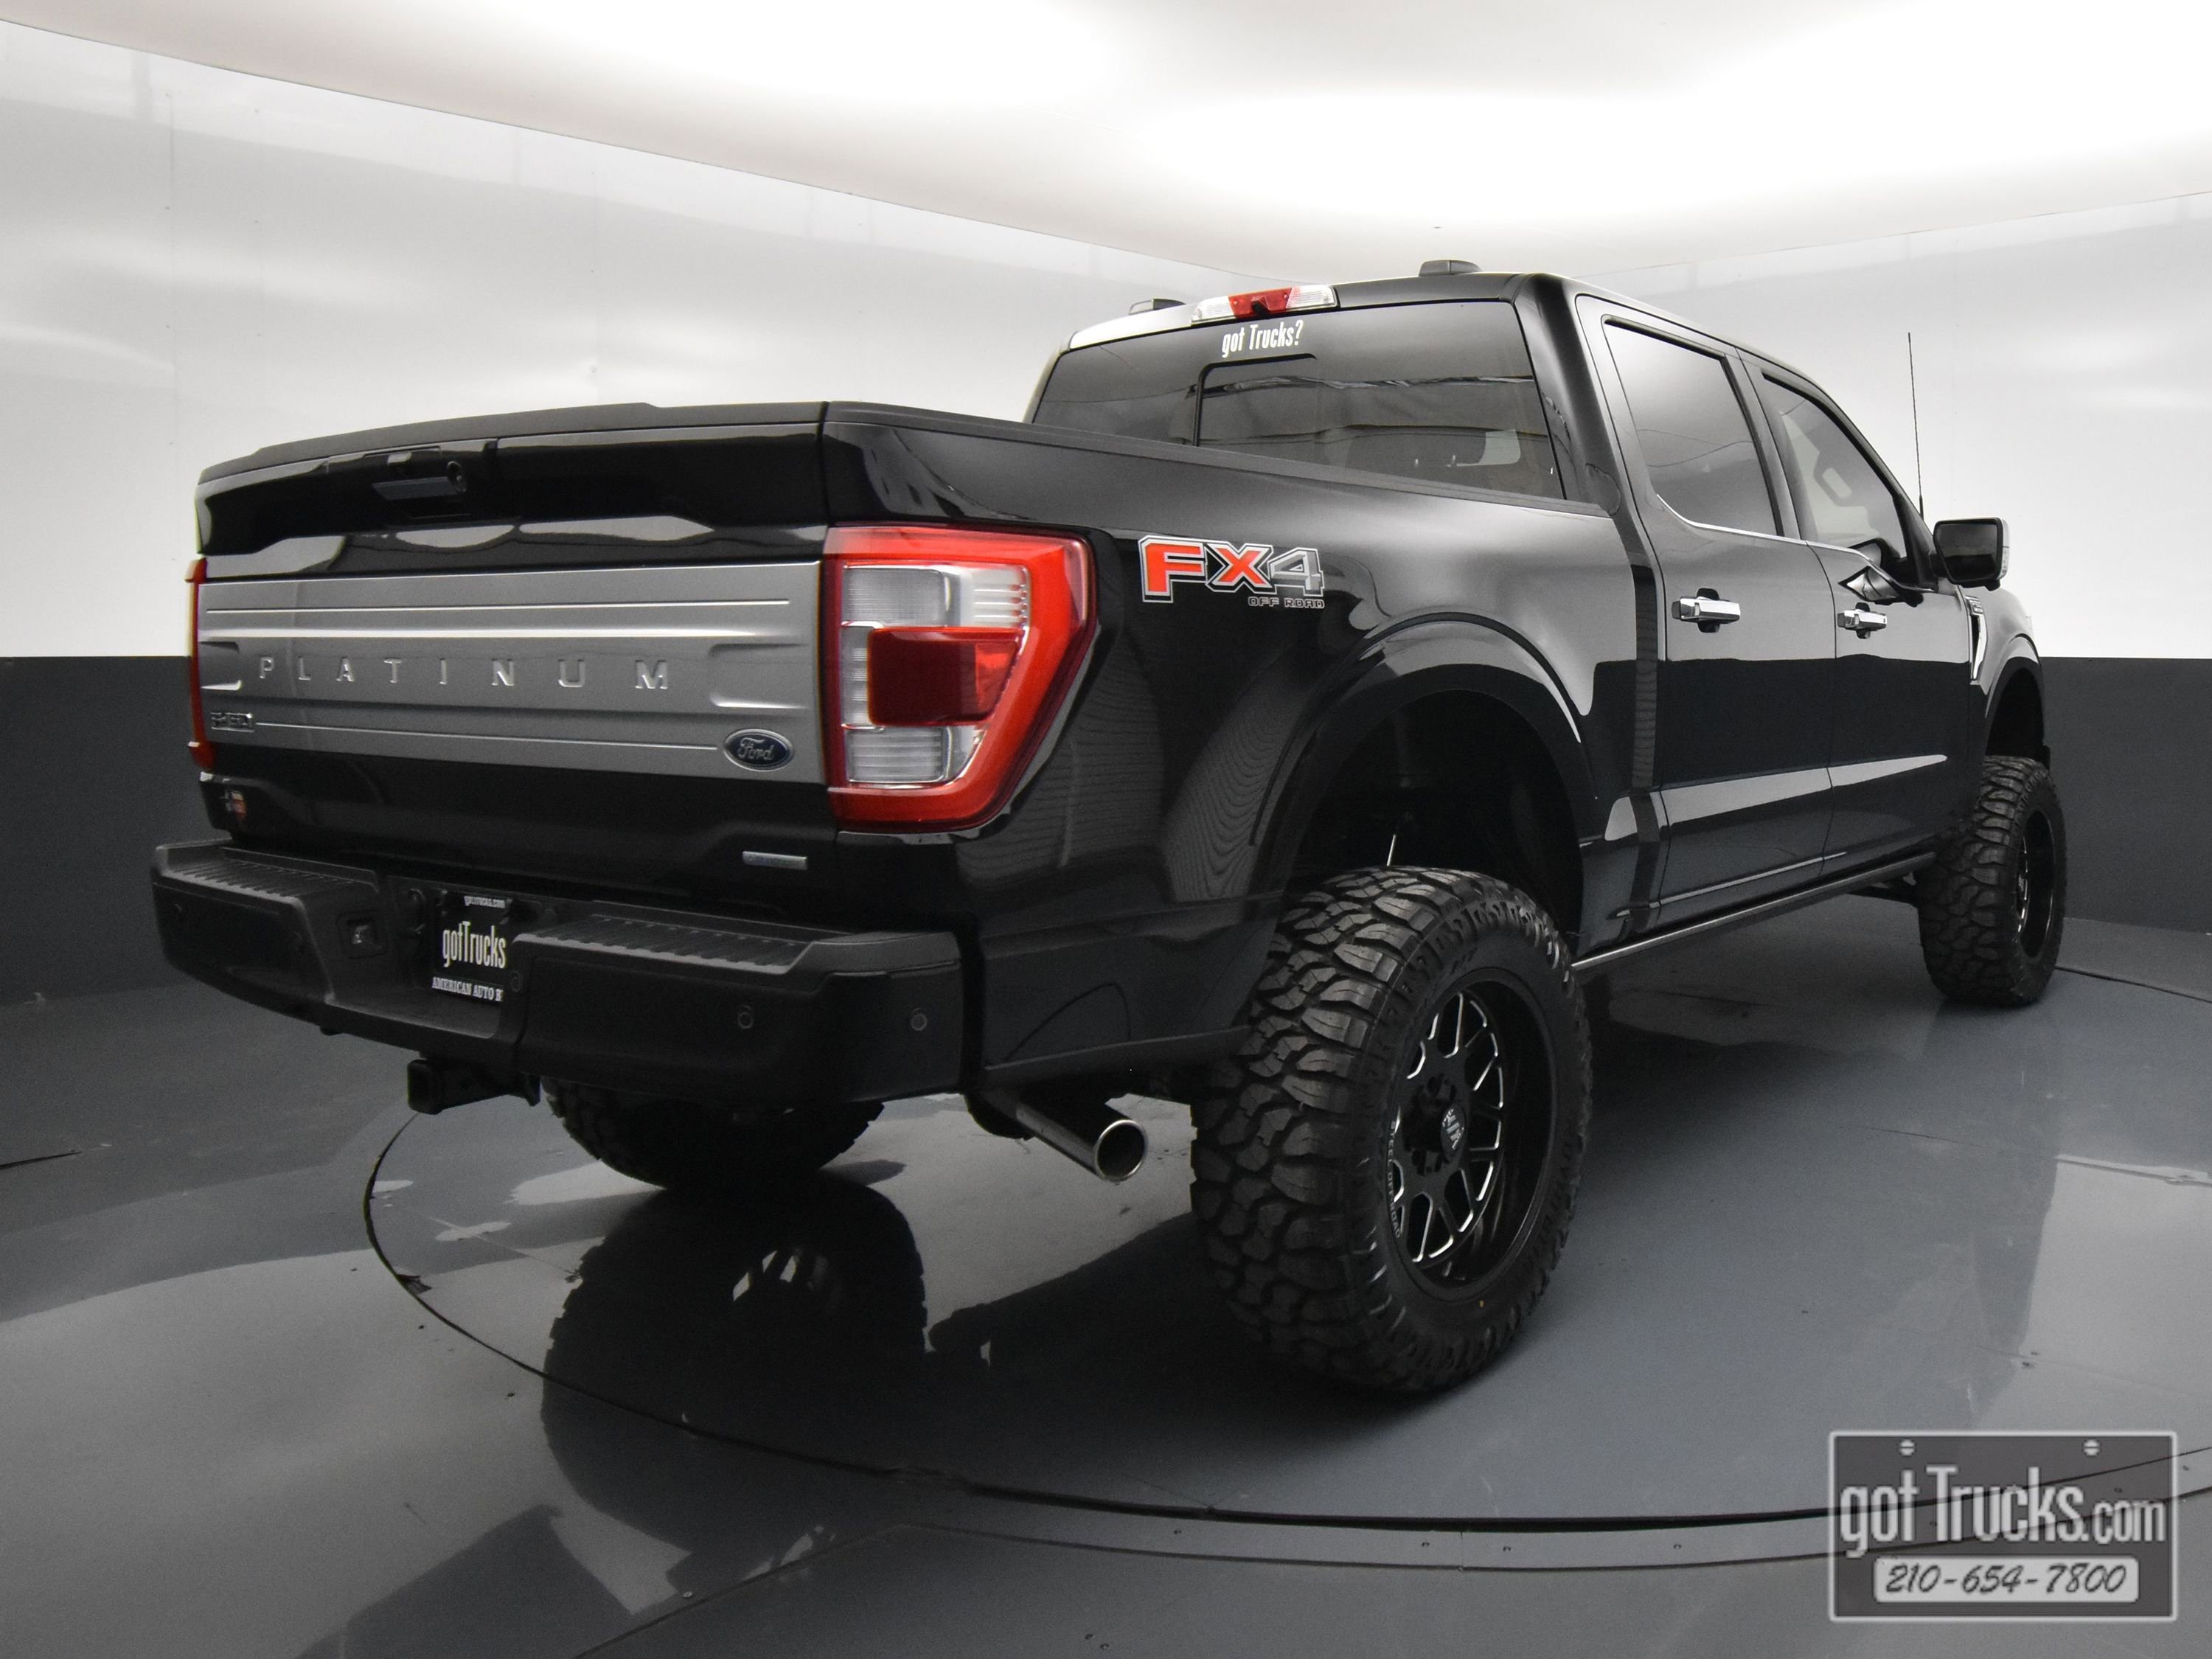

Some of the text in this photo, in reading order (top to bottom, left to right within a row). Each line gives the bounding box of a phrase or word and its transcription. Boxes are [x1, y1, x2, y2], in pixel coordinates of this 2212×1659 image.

[1221, 319, 1304, 358] got Trucks?
[1138, 535, 1326, 603] FX4
[1248, 596, 1326, 610] OFF ROAD
[259, 655, 669, 689] PLATINUM
[737, 737, 776, 761] Ford
[442, 920, 507, 970] gotTrucks
[431, 976, 473, 996] AMERICAN
[472, 984, 495, 1001] AUTO
